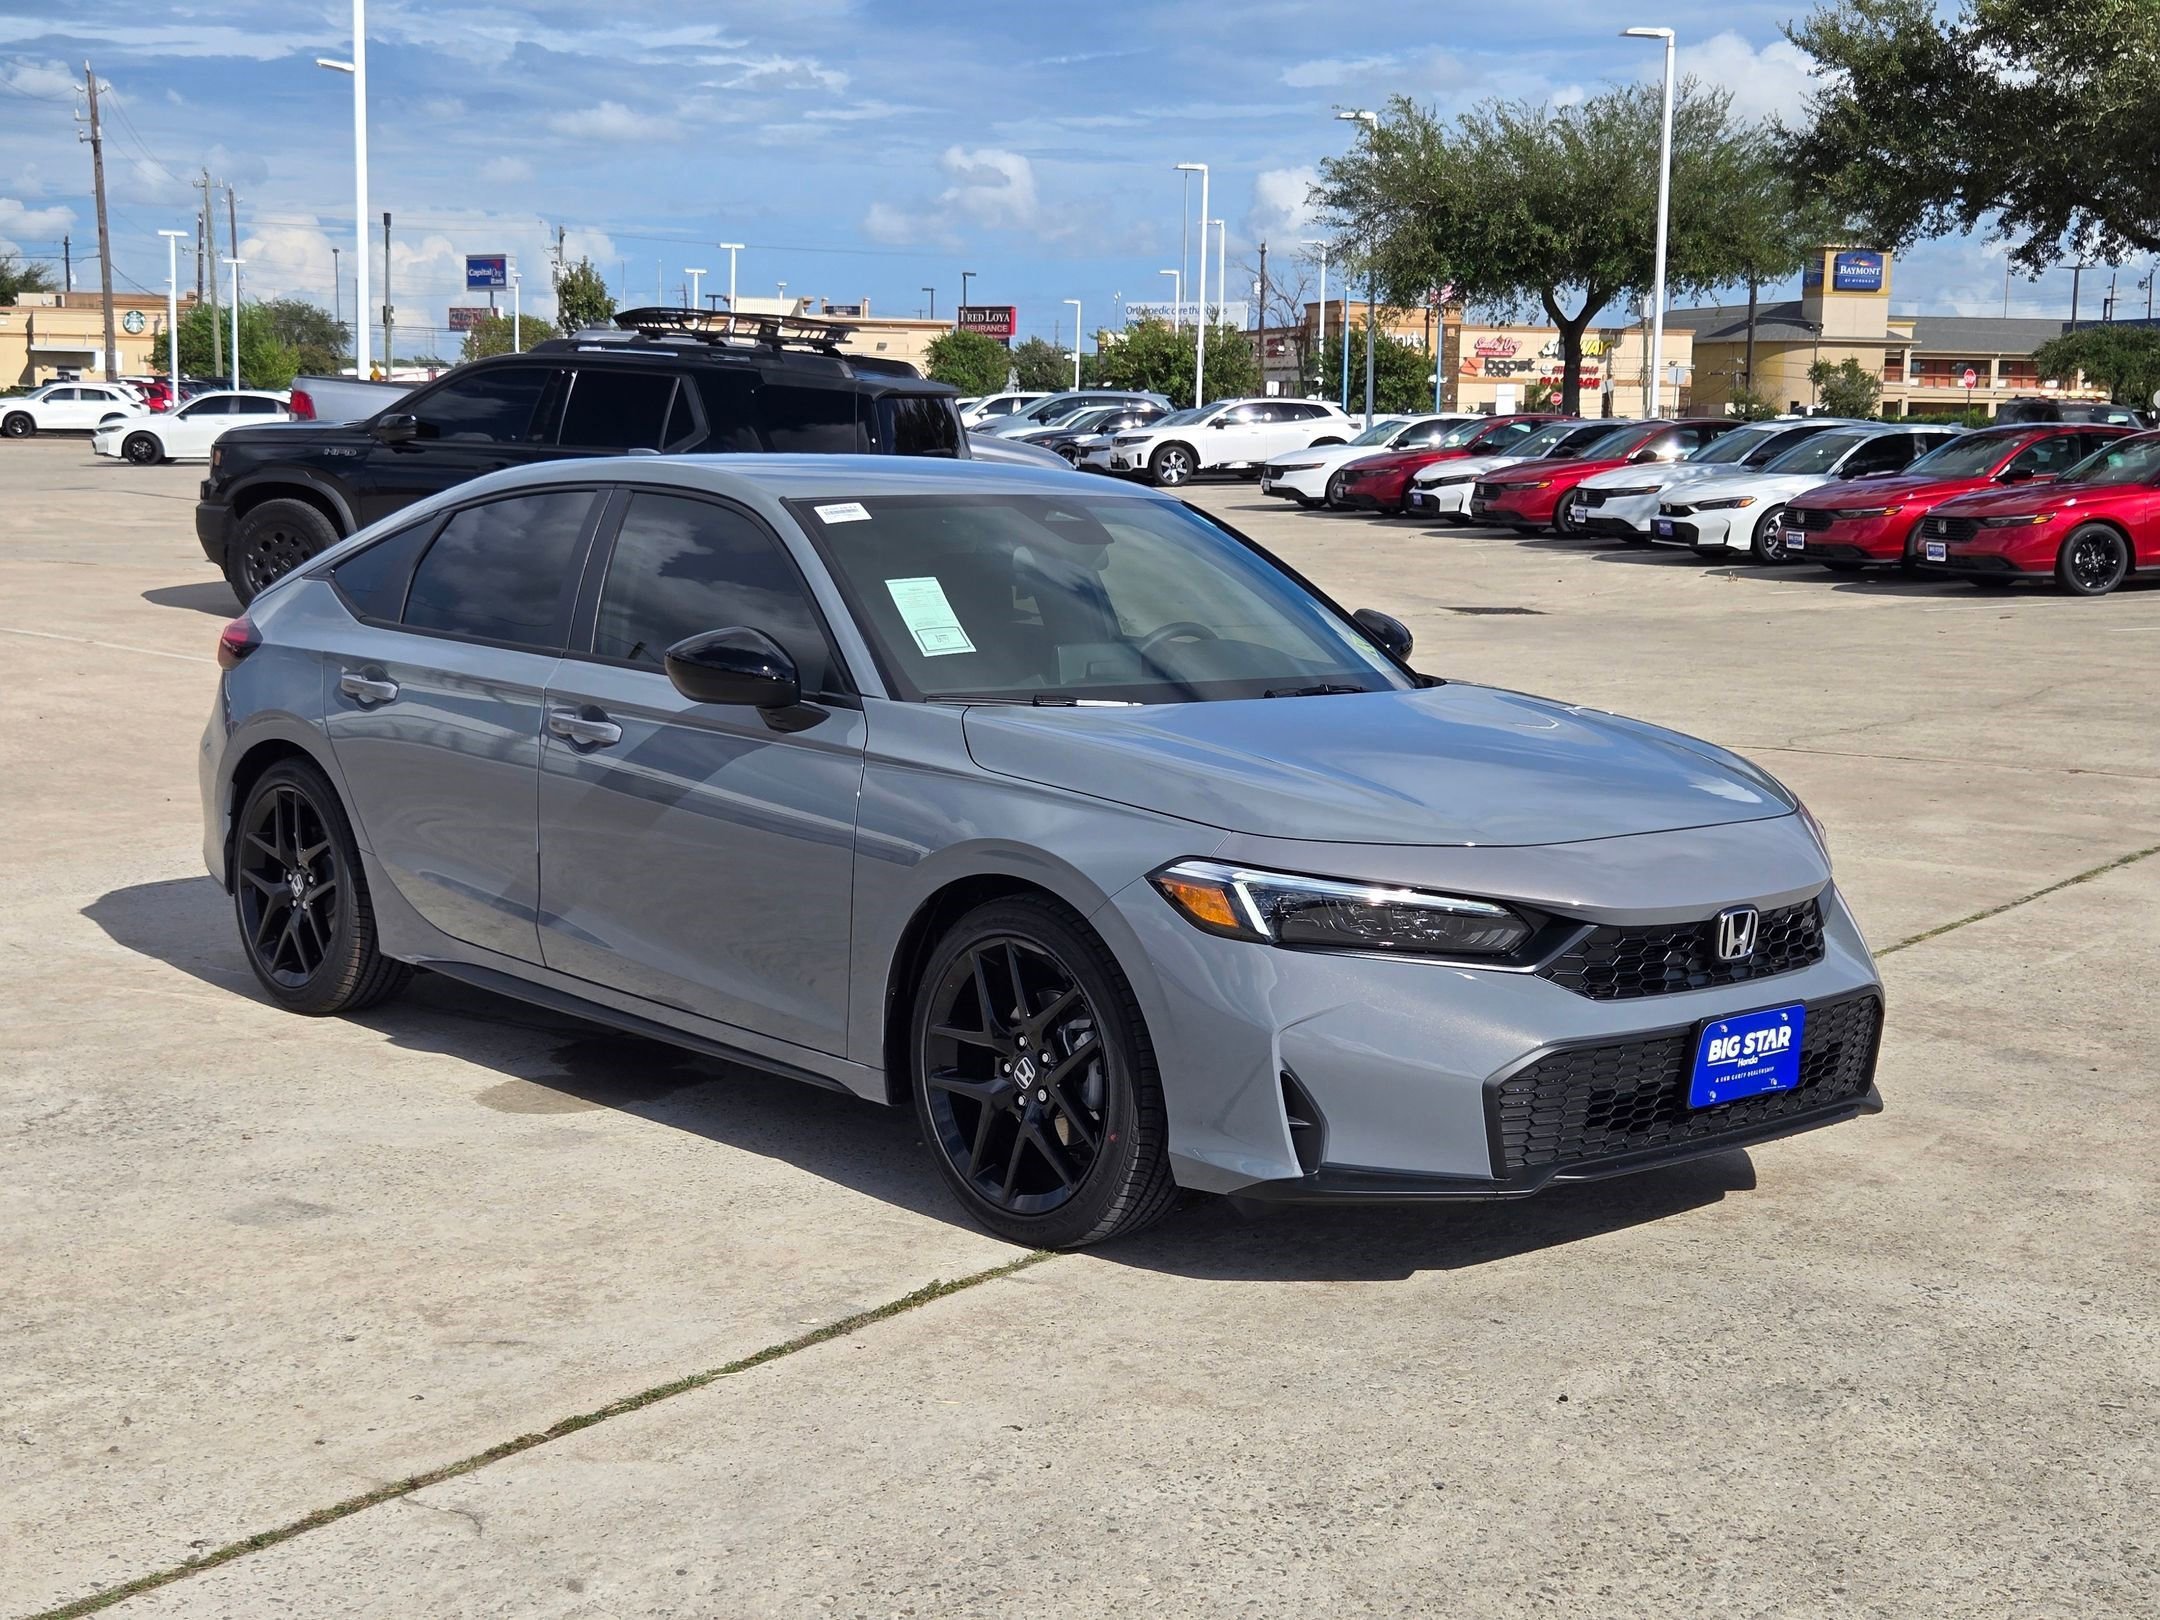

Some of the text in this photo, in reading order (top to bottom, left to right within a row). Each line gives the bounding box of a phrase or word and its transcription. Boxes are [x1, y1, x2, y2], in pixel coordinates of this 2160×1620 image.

[1840, 265, 1881, 275] BAYMONT
[985, 310, 1010, 322] LOYA
[1485, 357, 1535, 372] boost
[1707, 1025, 1792, 1062] BIG STAR
[1737, 1055, 1759, 1068] Honda
